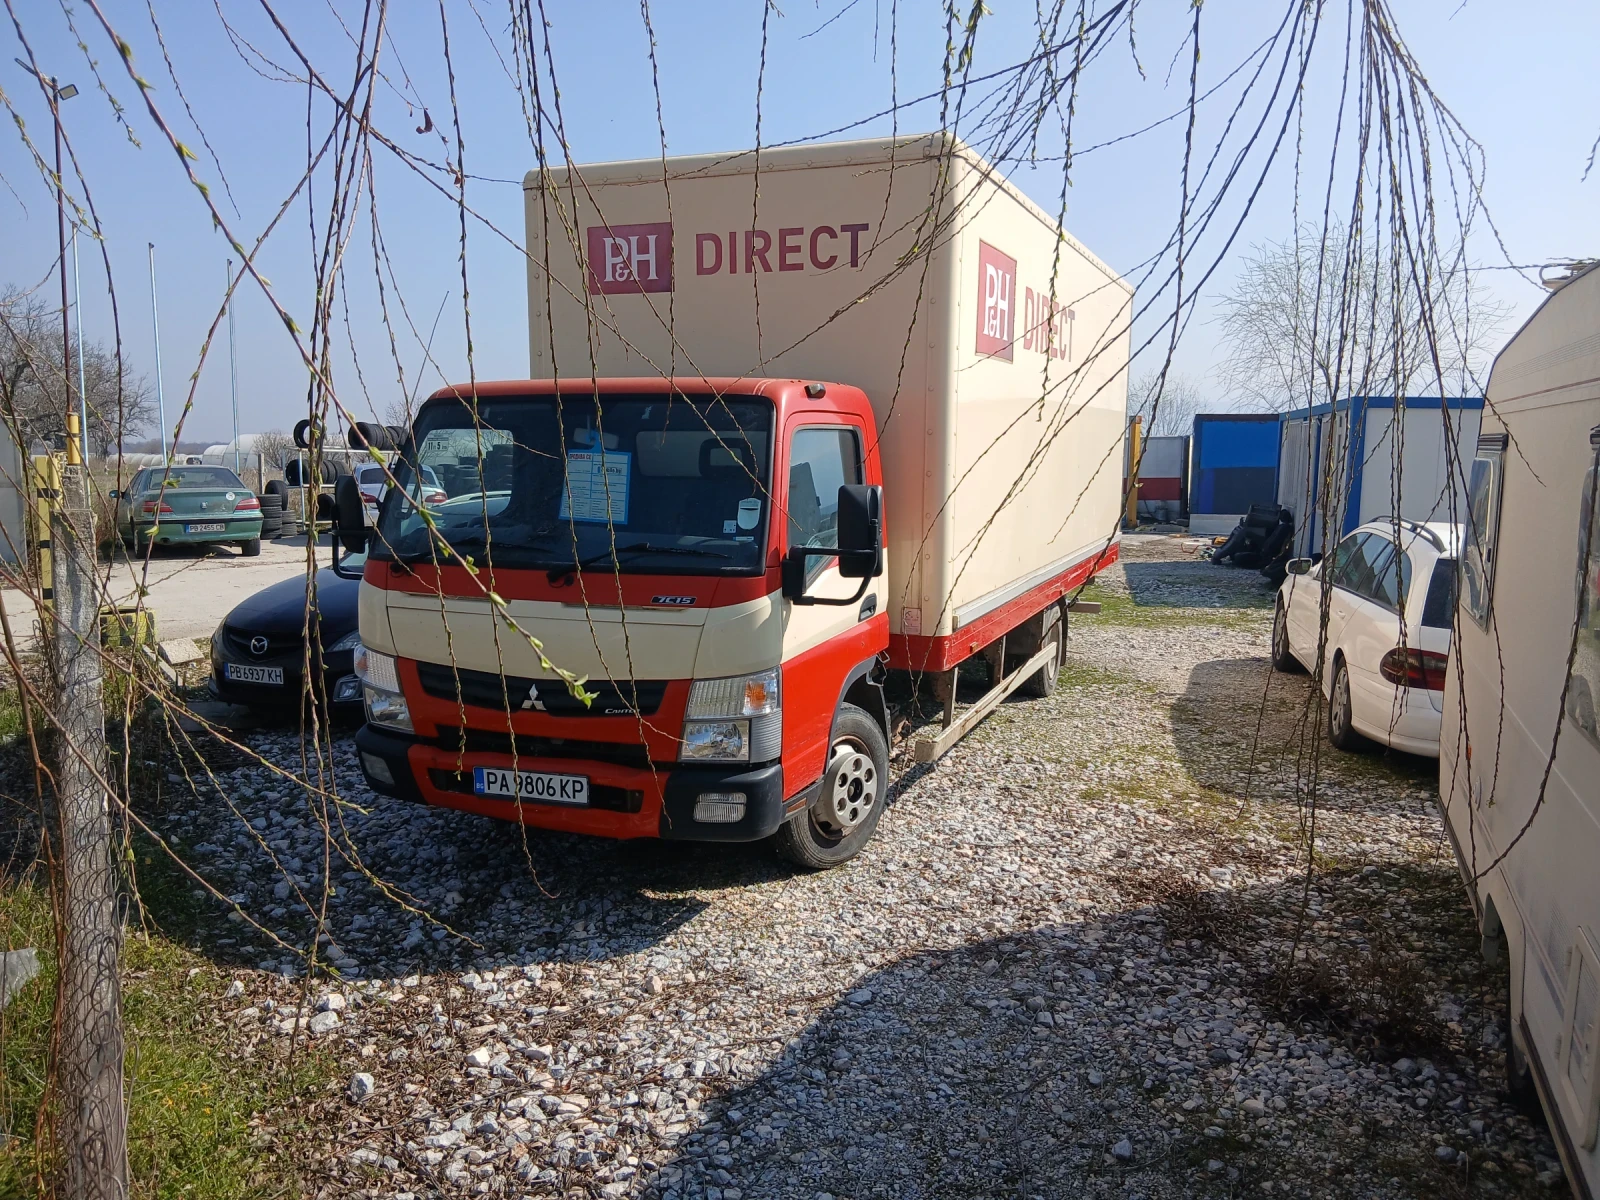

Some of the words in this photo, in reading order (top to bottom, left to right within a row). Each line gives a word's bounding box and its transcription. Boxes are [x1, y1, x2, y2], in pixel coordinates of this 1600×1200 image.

[603, 234, 659, 282] P&H
[695, 223, 869, 276] DIRECT
[983, 262, 1011, 341] P&H
[1023, 286, 1075, 362] DIRECT
[657, 596, 692, 604] 7C15
[229, 665, 242, 678] PB
[243, 667, 266, 681] 6937
[267, 669, 283, 682] KH
[486, 771, 510, 792] PA
[513, 774, 557, 797] 9806
[560, 778, 584, 799] KP
